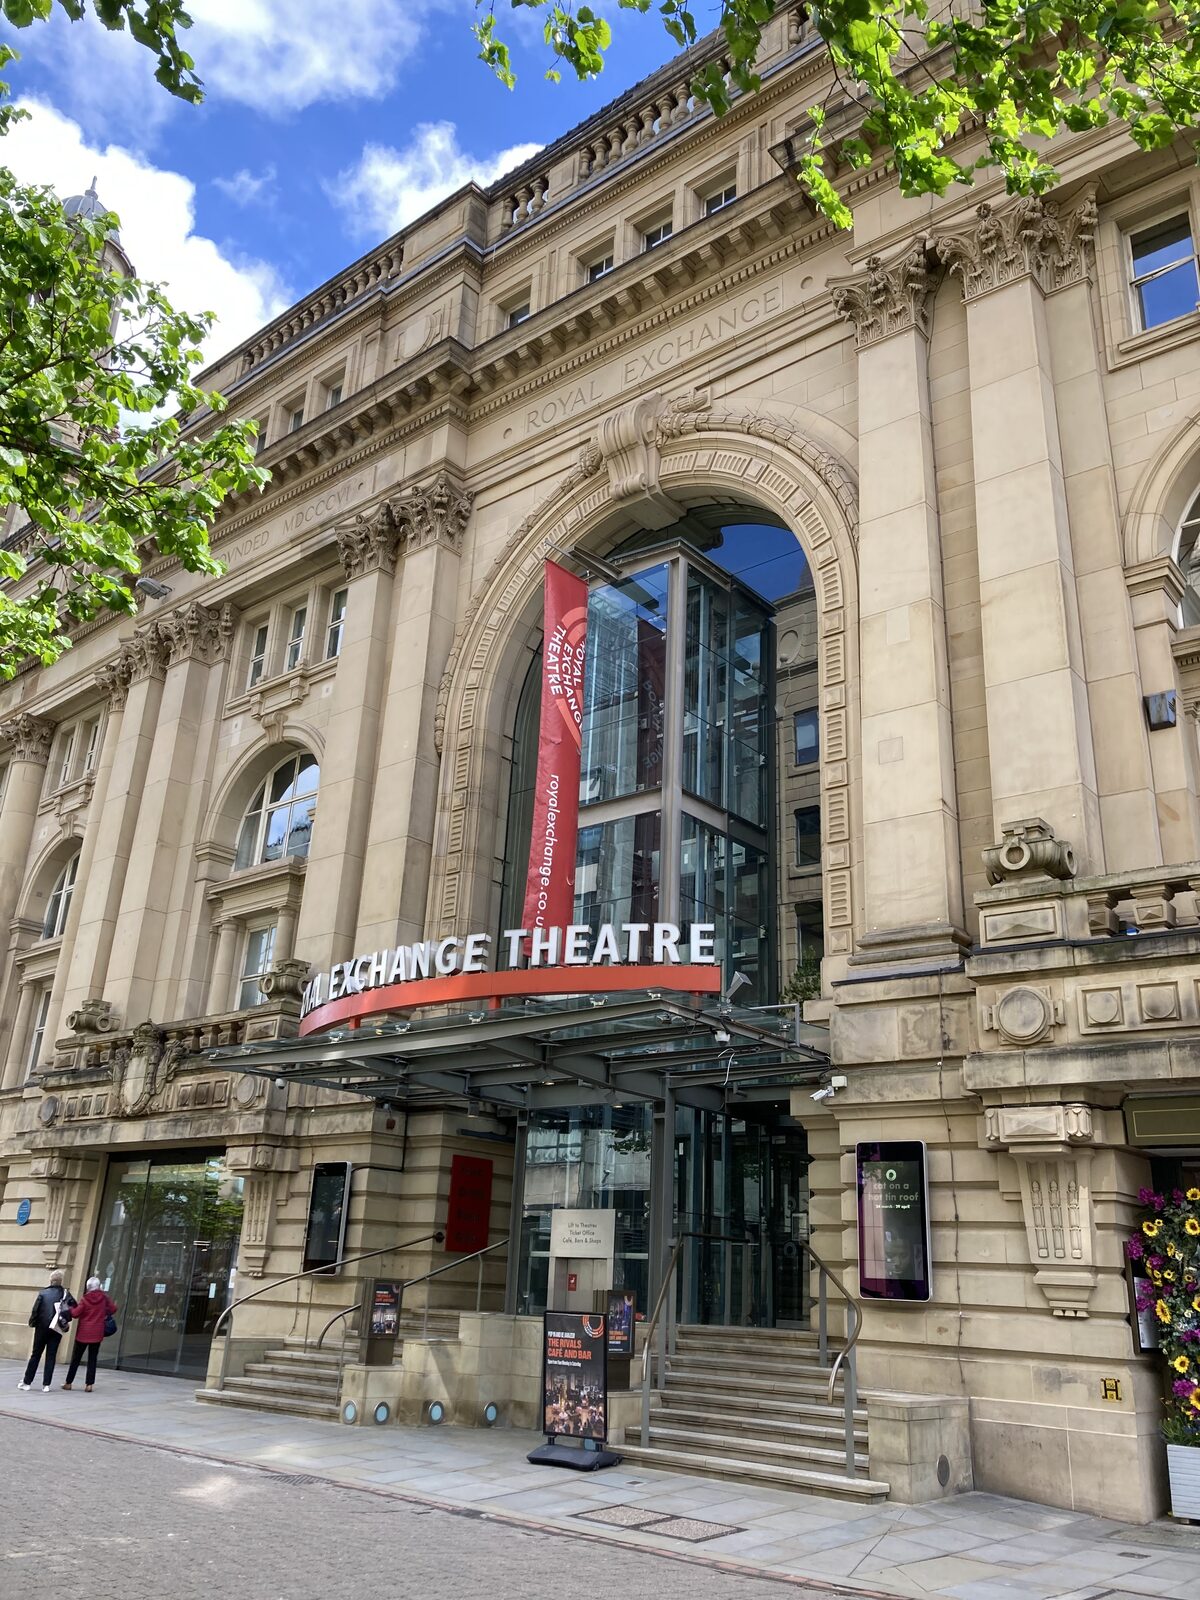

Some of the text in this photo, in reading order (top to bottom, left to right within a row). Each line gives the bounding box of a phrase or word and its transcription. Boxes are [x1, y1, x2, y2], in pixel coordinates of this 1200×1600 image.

[525, 285, 782, 434] ROYAL EXCHANGE
[546, 624, 567, 695] THEATRE
[535, 774, 561, 930] royalexchange.co.u
[328, 932, 491, 1001] EXCHANGE
[503, 922, 716, 968] THEATRE
[868, 1191, 919, 1201] hot tin roof
[872, 1182, 886, 1190] cat
[889, 1182, 901, 1190] on
[548, 1338, 582, 1349] THE RIVALS
[548, 1348, 592, 1360] CAFÉ AND BAR
[1100, 1378, 1122, 1400] H
